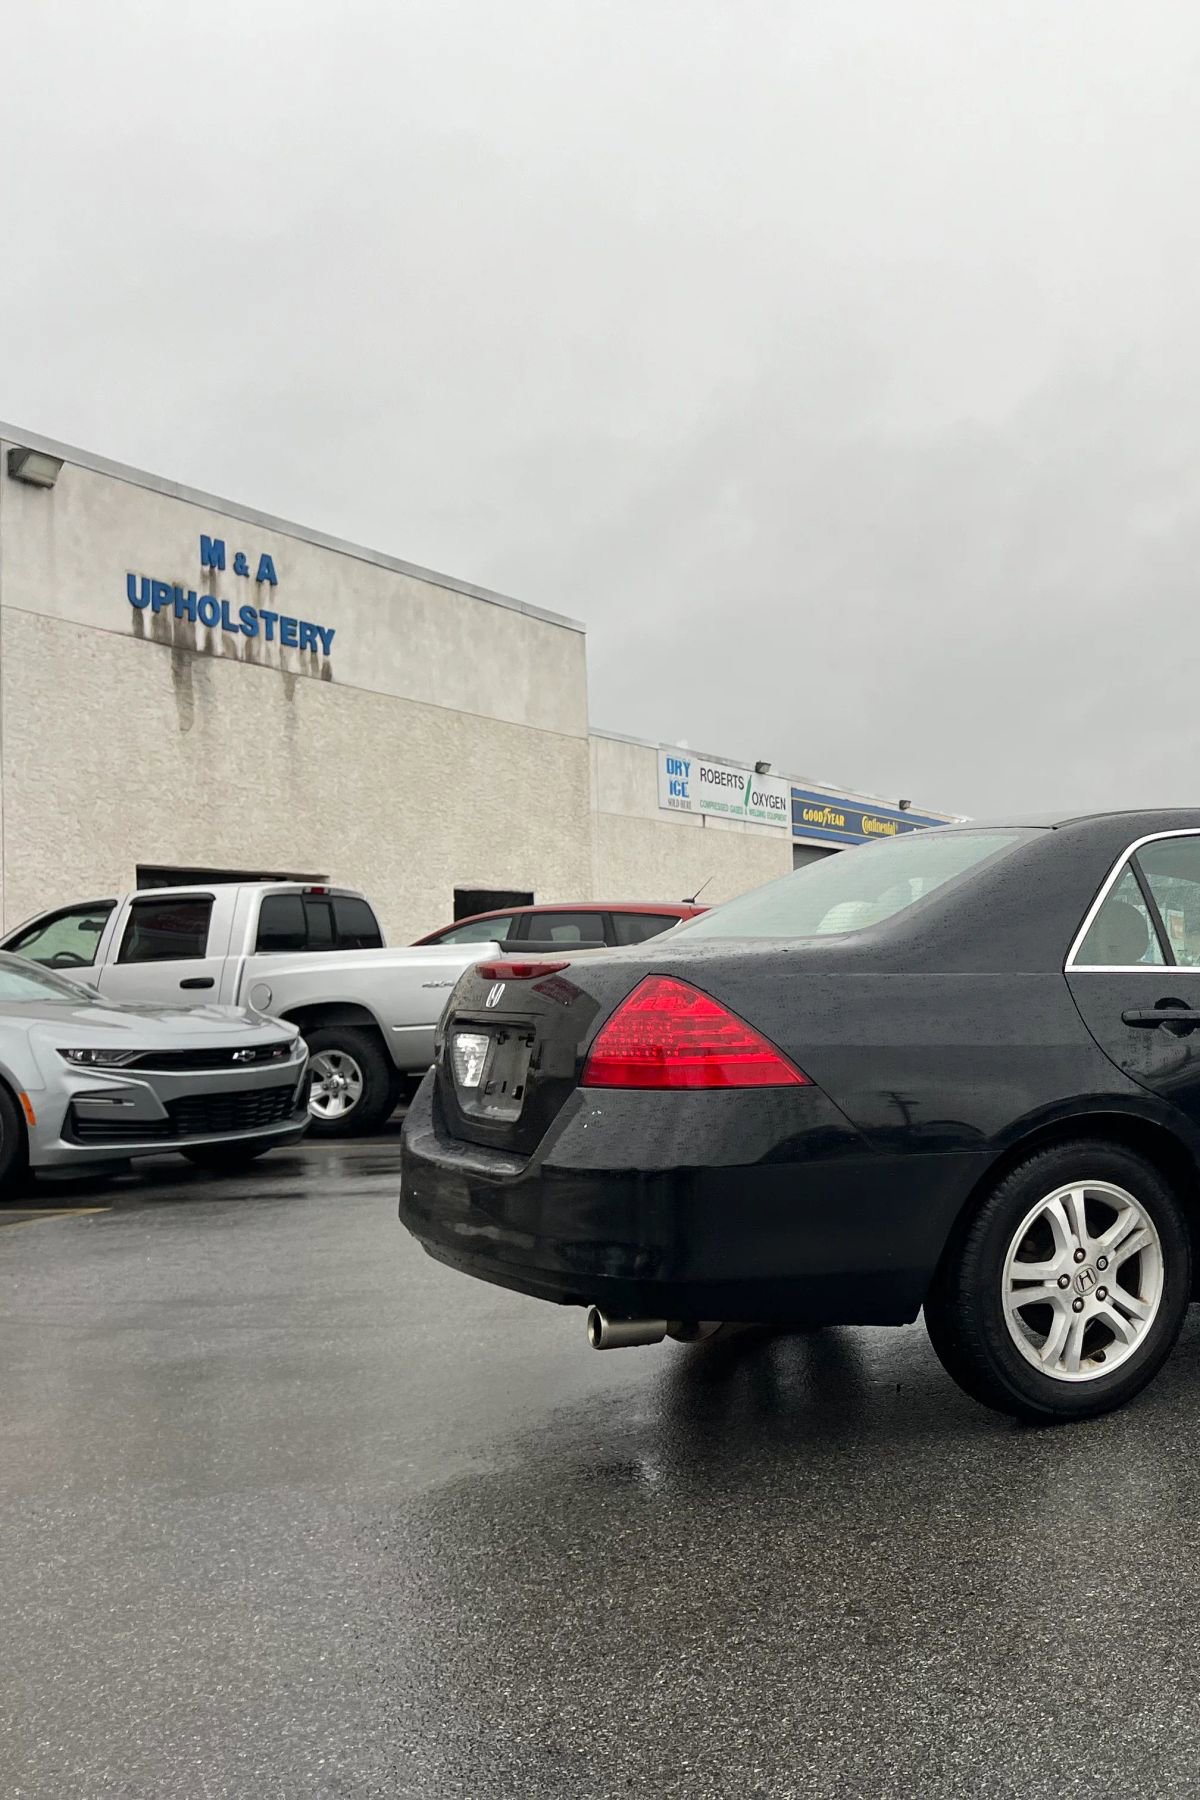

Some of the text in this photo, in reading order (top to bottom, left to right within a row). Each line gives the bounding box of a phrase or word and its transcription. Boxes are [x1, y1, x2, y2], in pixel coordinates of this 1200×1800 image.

[200, 534, 278, 586] M & A
[126, 573, 336, 656] UPHOLSTERY
[666, 757, 691, 778] DRY
[669, 780, 690, 798] ICE
[700, 767, 745, 791] ROBERTS
[751, 791, 787, 811] OXYGEN
[803, 807, 845, 827] GOODYEAR
[861, 815, 897, 836] Continental
